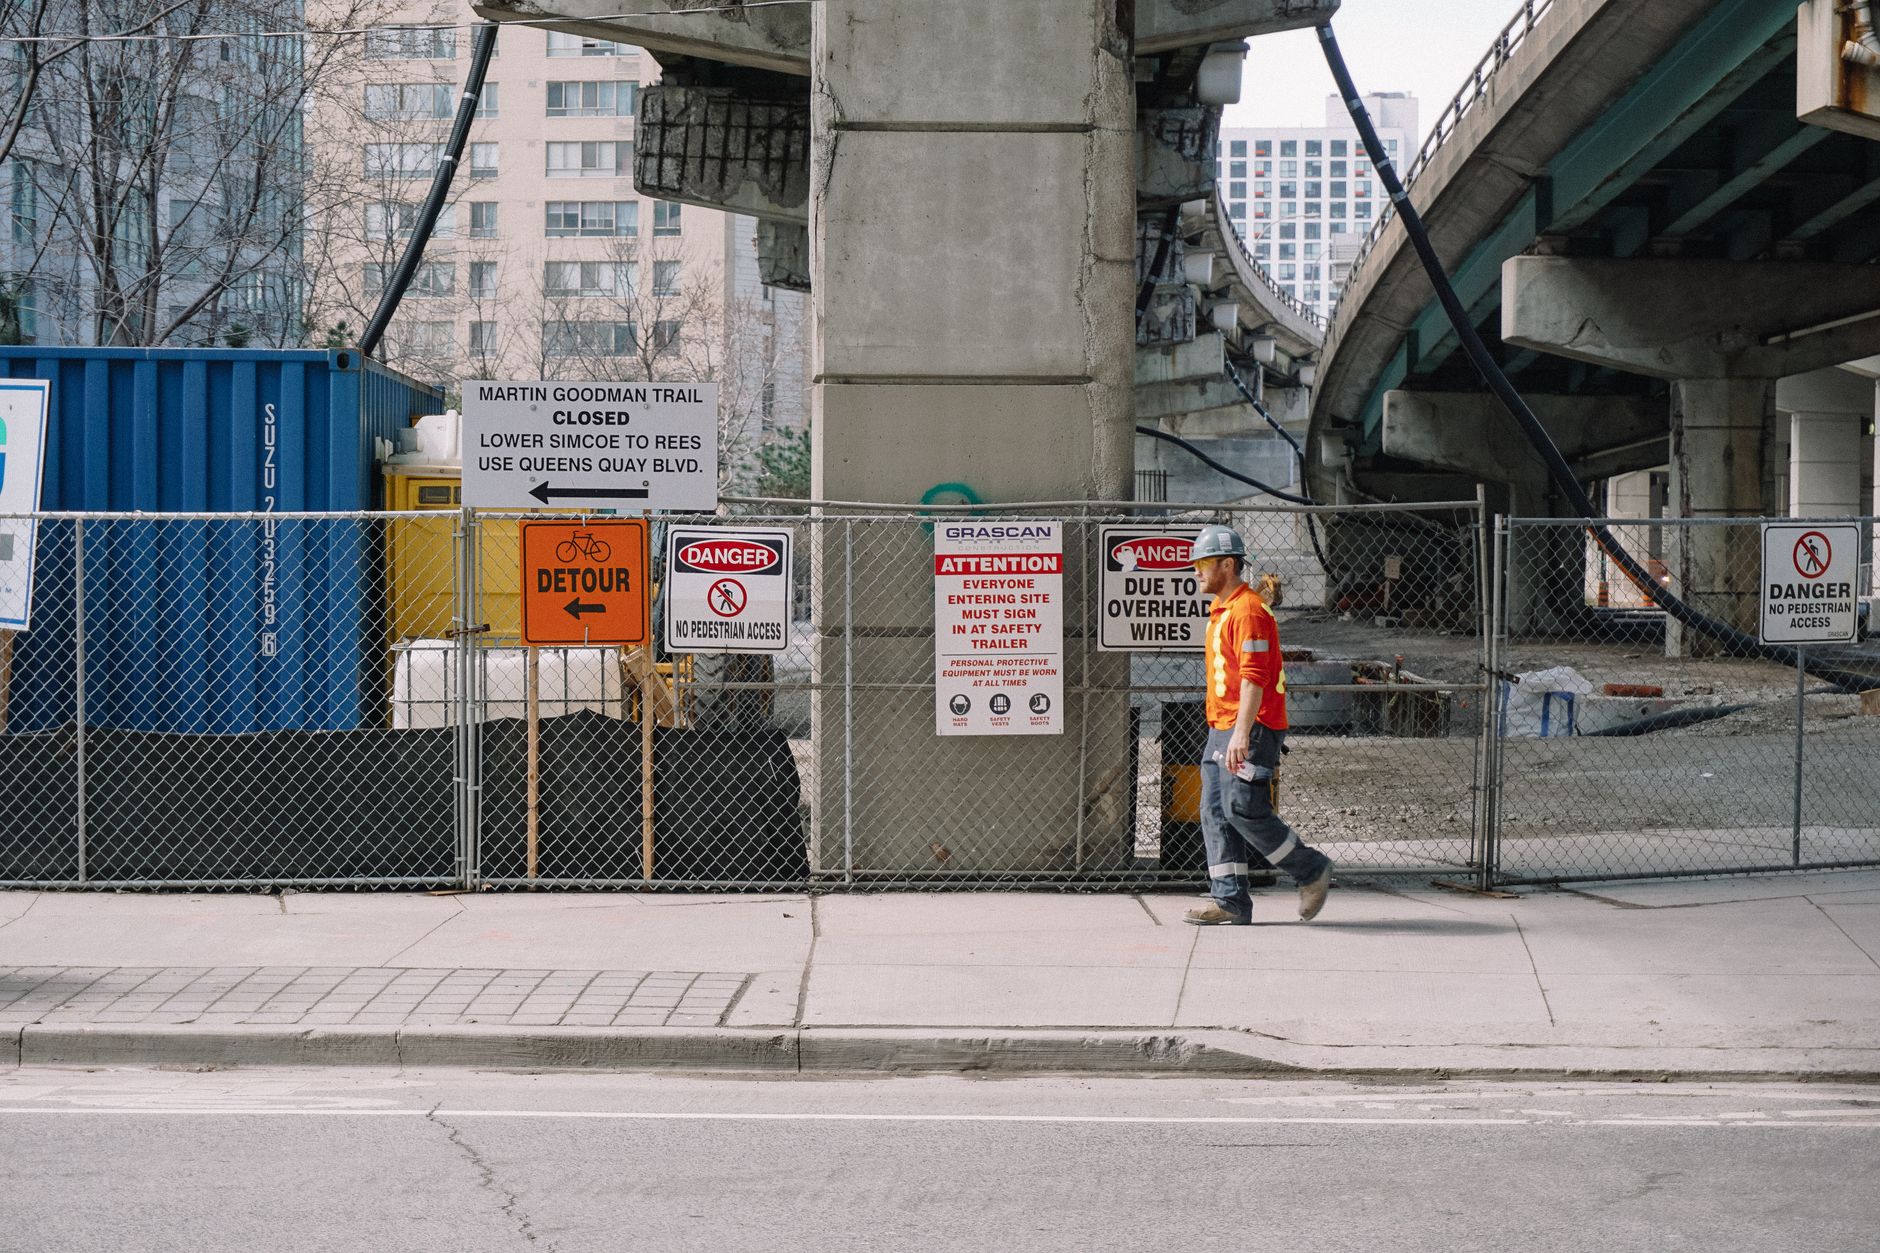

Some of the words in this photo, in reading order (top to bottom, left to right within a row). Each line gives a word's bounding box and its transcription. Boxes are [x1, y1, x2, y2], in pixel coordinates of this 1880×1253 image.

[479, 387, 547, 401] MARTIN
[553, 387, 647, 403] GOODMAN
[652, 388, 703, 403] TRAIL
[552, 411, 630, 426] CLOSED
[264, 403, 276, 489] SUZU
[480, 434, 544, 448] LOWER
[550, 434, 620, 449] SIMCOE
[625, 435, 649, 449] TO
[655, 435, 702, 450] REES
[478, 457, 514, 472] USE
[519, 457, 593, 473] QUEENS
[598, 458, 648, 473] QUAY
[652, 459, 703, 473] BLVD.
[946, 526, 1051, 538] GRASCAN
[687, 547, 769, 565] DANGER
[941, 556, 1057, 572] ATTENTION
[537, 567, 630, 593] DETOUR
[963, 579, 1035, 589] EVERYONE
[1125, 578, 1164, 595] DUE
[1171, 578, 1196, 596] TO
[948, 594, 1016, 604] ENTERING
[1020, 594, 1050, 604] SITE
[1769, 583, 1850, 599] DANGER
[962, 609, 1000, 619] MUST
[1004, 609, 1036, 618] SIGN
[1107, 599, 1212, 618] OVERHEAD
[1769, 604, 1784, 614] NO
[1788, 602, 1851, 614] PEDESTRIAN
[675, 620, 688, 638] NO
[691, 620, 745, 639] PEDESTRIAN
[747, 622, 781, 640] ACCESS
[952, 624, 966, 634] IN
[971, 624, 987, 634] AT
[991, 623, 1042, 634] SAFETY
[1790, 617, 1831, 628] ACCESS
[1130, 623, 1191, 641] WIRES
[263, 633, 276, 656] 6
[971, 639, 1028, 649] TRAILER
[950, 659, 994, 667] PERSONAL
[942, 669, 991, 677] EQUIPMENT
